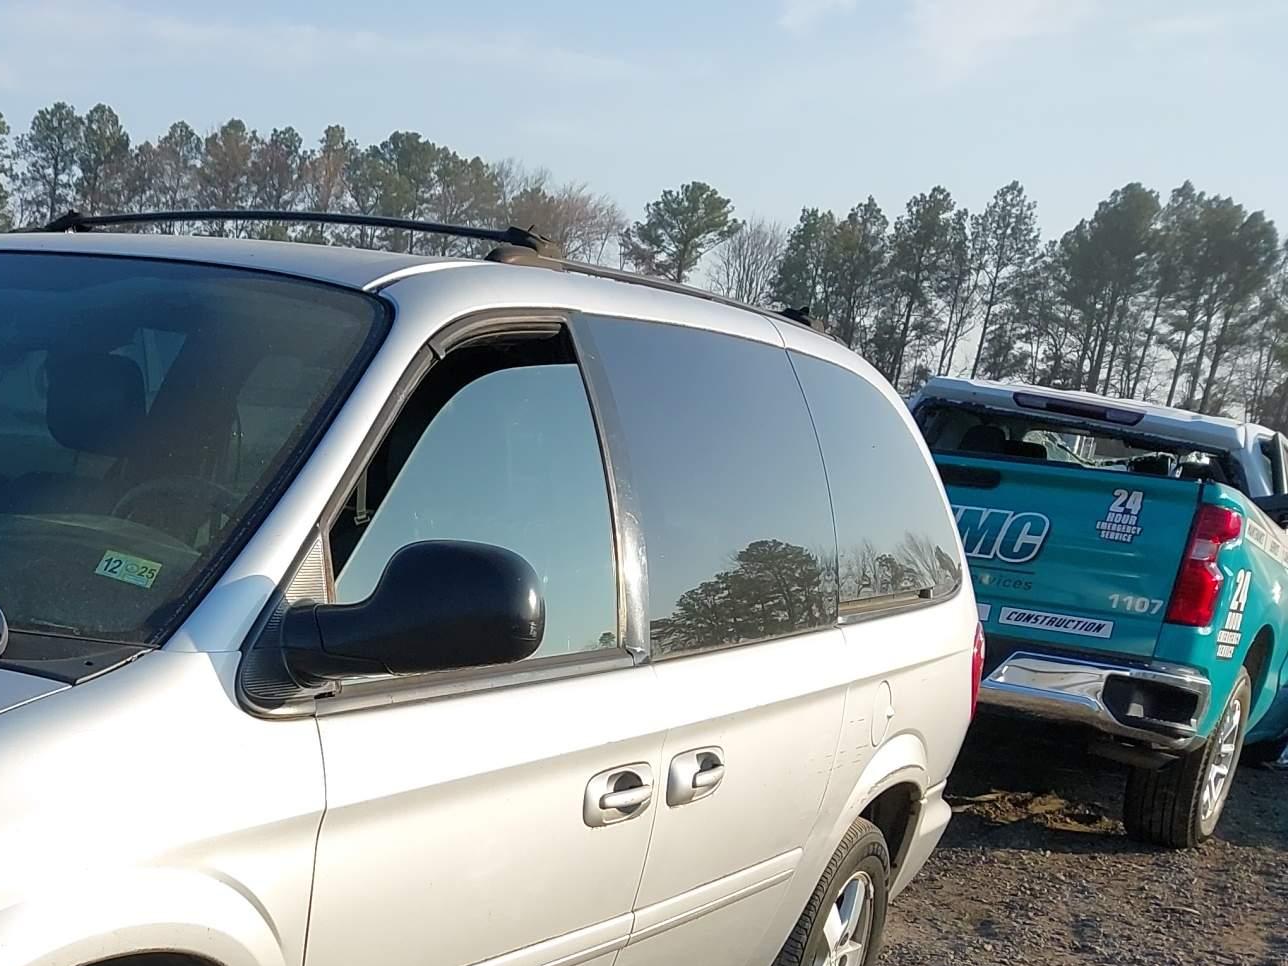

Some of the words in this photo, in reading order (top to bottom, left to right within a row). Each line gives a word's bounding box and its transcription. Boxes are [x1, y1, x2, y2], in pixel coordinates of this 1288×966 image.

[1109, 489, 1143, 515] 24
[1095, 520, 1142, 535] EMERGENCY
[1106, 511, 1138, 526] HOUR
[952, 505, 1050, 563] MC
[1100, 530, 1133, 542] SERVICE
[103, 557, 123, 574] 12
[136, 566, 157, 579] 25
[973, 573, 1032, 591] ervices
[1109, 593, 1163, 615] 1107
[1006, 610, 1106, 634] CONSTRUCTION
